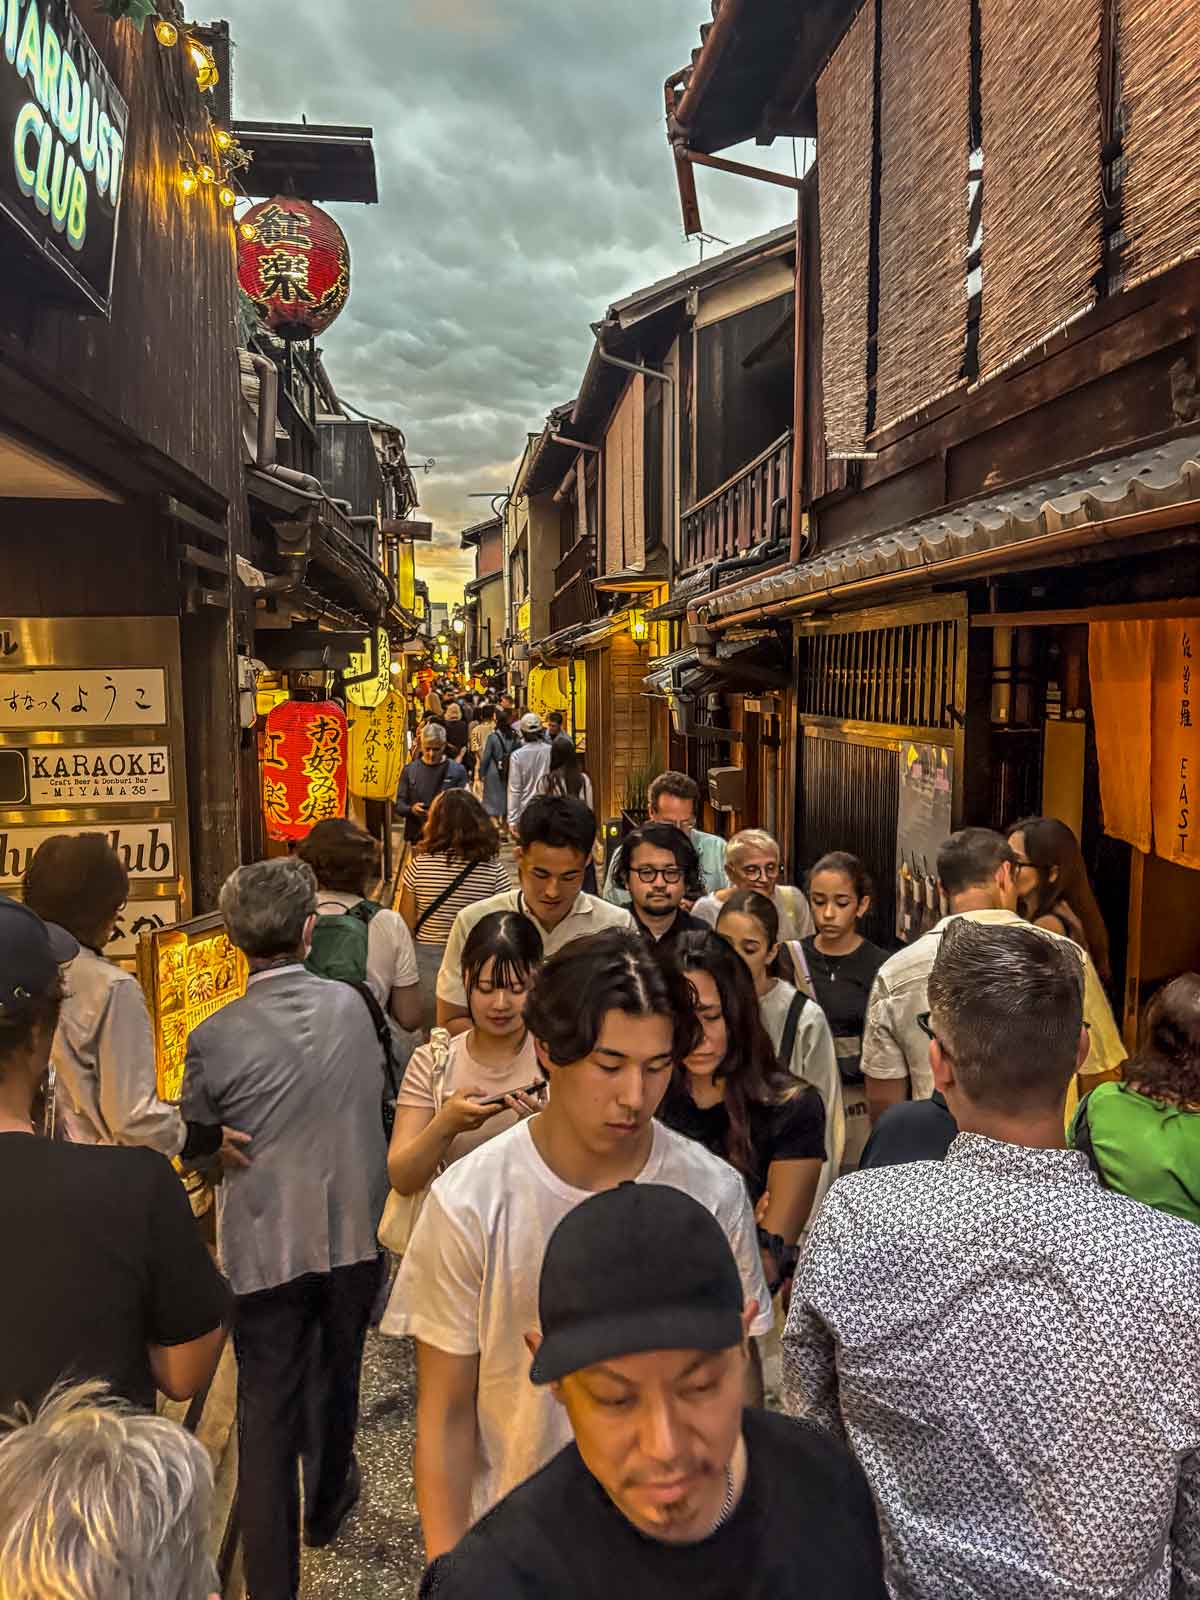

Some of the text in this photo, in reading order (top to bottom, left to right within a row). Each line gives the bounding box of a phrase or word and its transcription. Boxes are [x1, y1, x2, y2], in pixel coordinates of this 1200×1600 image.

[14, 102, 87, 247] CLUB
[32, 753, 166, 778] KARAOKE
[49, 778, 72, 787] Craft
[74, 778, 91, 786] Beer
[102, 777, 133, 785] Donburi
[135, 777, 149, 785] Bar
[1178, 758, 1189, 853] EAST
[107, 828, 170, 872] lub
